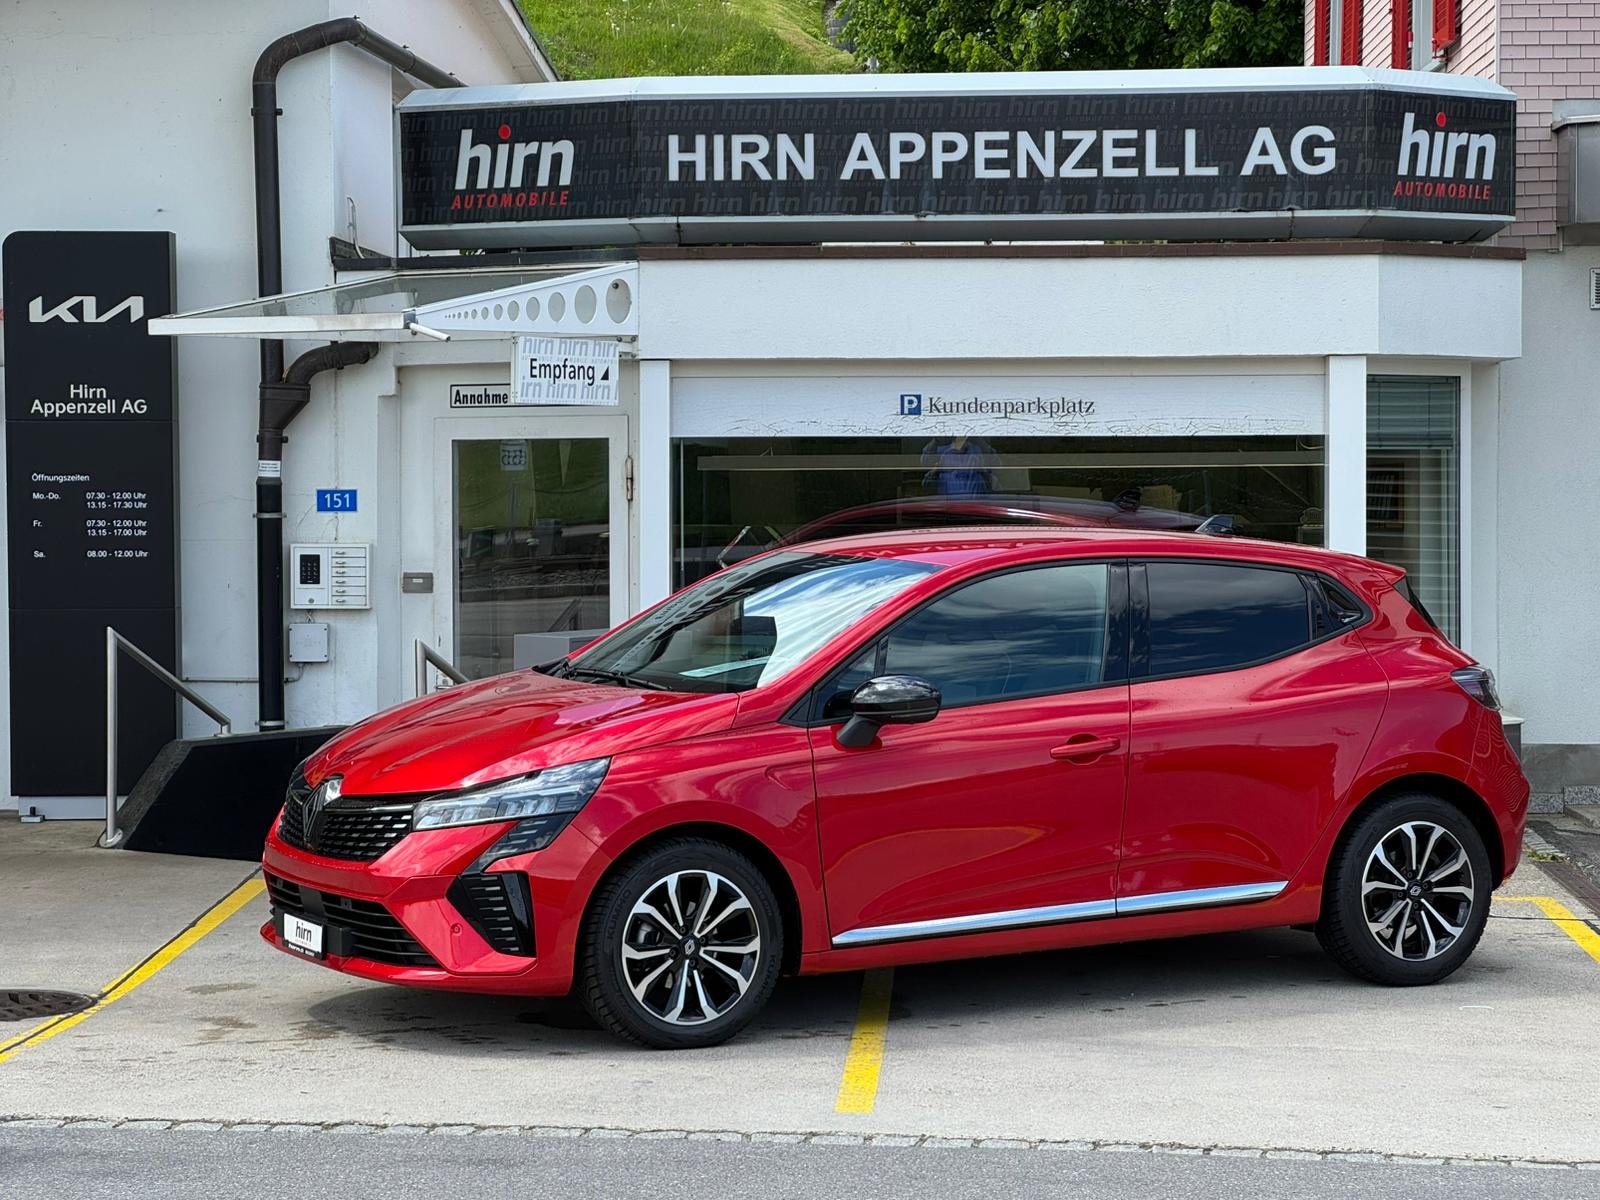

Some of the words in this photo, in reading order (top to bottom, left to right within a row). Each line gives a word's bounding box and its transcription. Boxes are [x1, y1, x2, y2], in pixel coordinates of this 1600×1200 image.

[669, 134, 814, 181] HIRN
[840, 129, 1218, 179] APPENZELL
[1240, 126, 1335, 175] AG
[1398, 113, 1496, 179] hirn
[455, 126, 574, 189] hirn
[452, 191, 567, 209] AUTOMOBILE
[1395, 183, 1489, 200] AUTOMOBILE
[29, 296, 144, 323] KIA
[530, 358, 595, 386] Empfang
[70, 384, 106, 399] Hirn
[454, 388, 508, 405] Annahme
[31, 400, 116, 417] Appenzell
[121, 400, 147, 414] AG
[928, 397, 1095, 418] Kundenparkplatz
[31, 473, 90, 483] Öffnungszeiten
[32, 492, 61, 500] Mo.-Do.
[324, 493, 350, 508] 151
[295, 920, 312, 942] hirn
